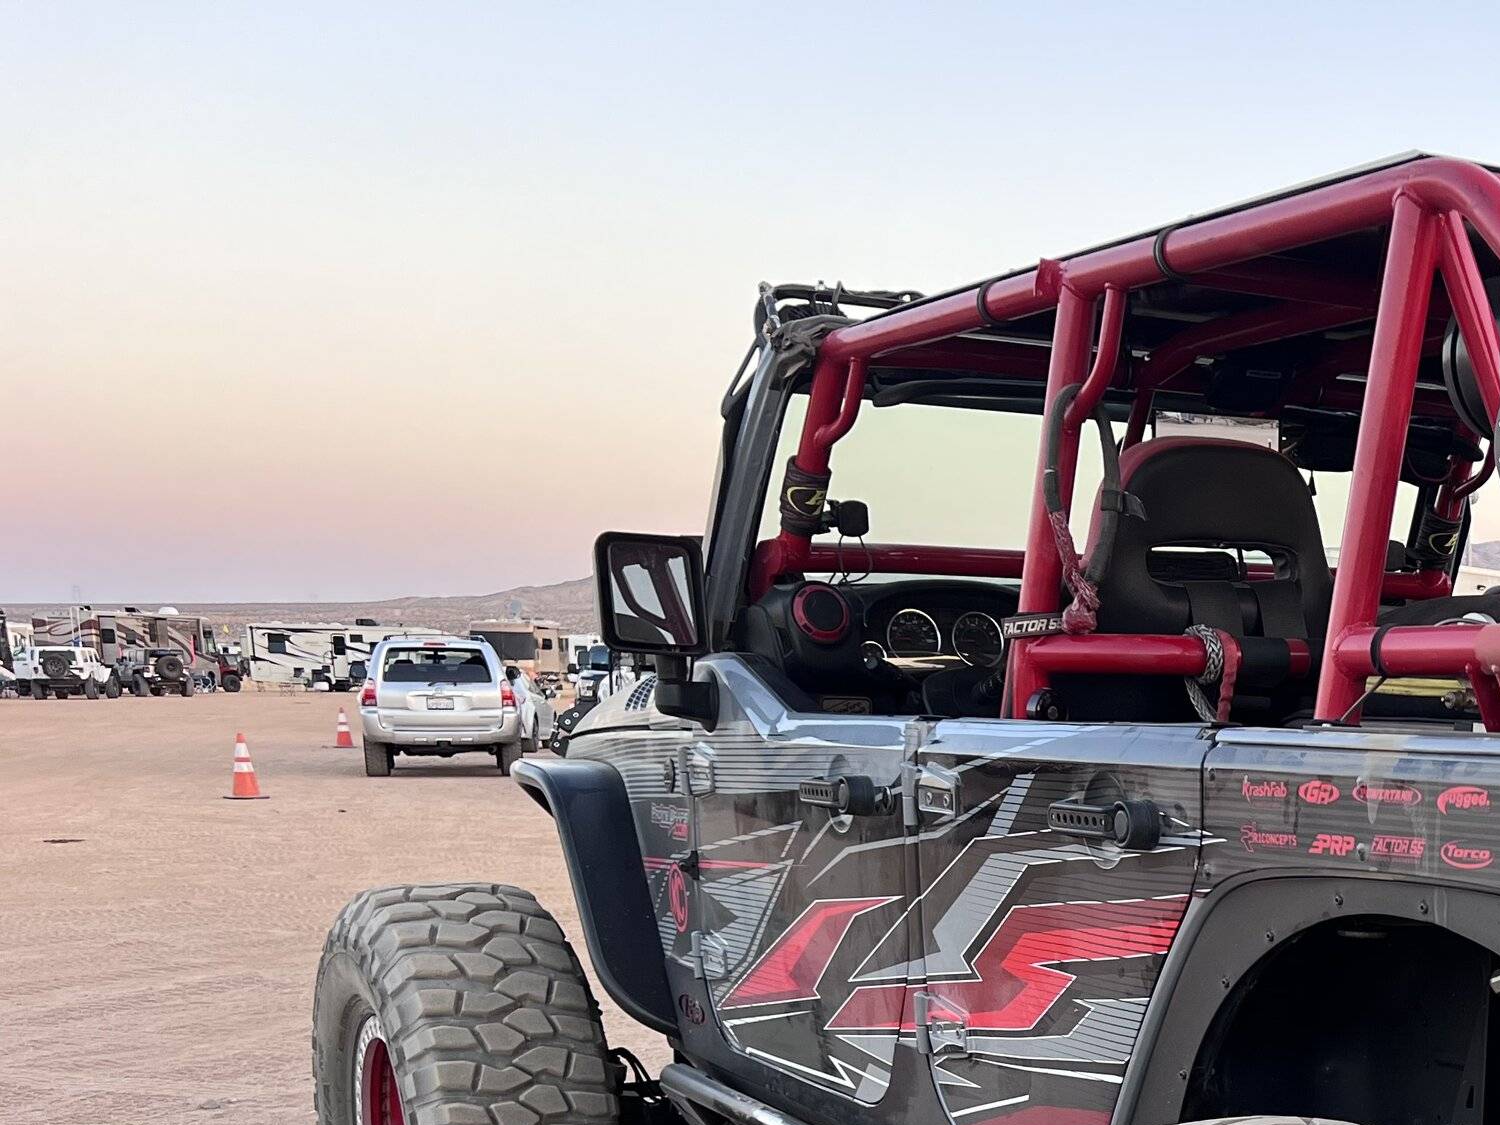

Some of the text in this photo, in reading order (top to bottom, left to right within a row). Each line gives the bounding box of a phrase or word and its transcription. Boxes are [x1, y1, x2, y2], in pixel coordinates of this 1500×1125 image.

[1003, 618, 1064, 636] FACTOR 5
[1371, 837, 1408, 853] FACTOR
[1448, 844, 1491, 860] Torco
